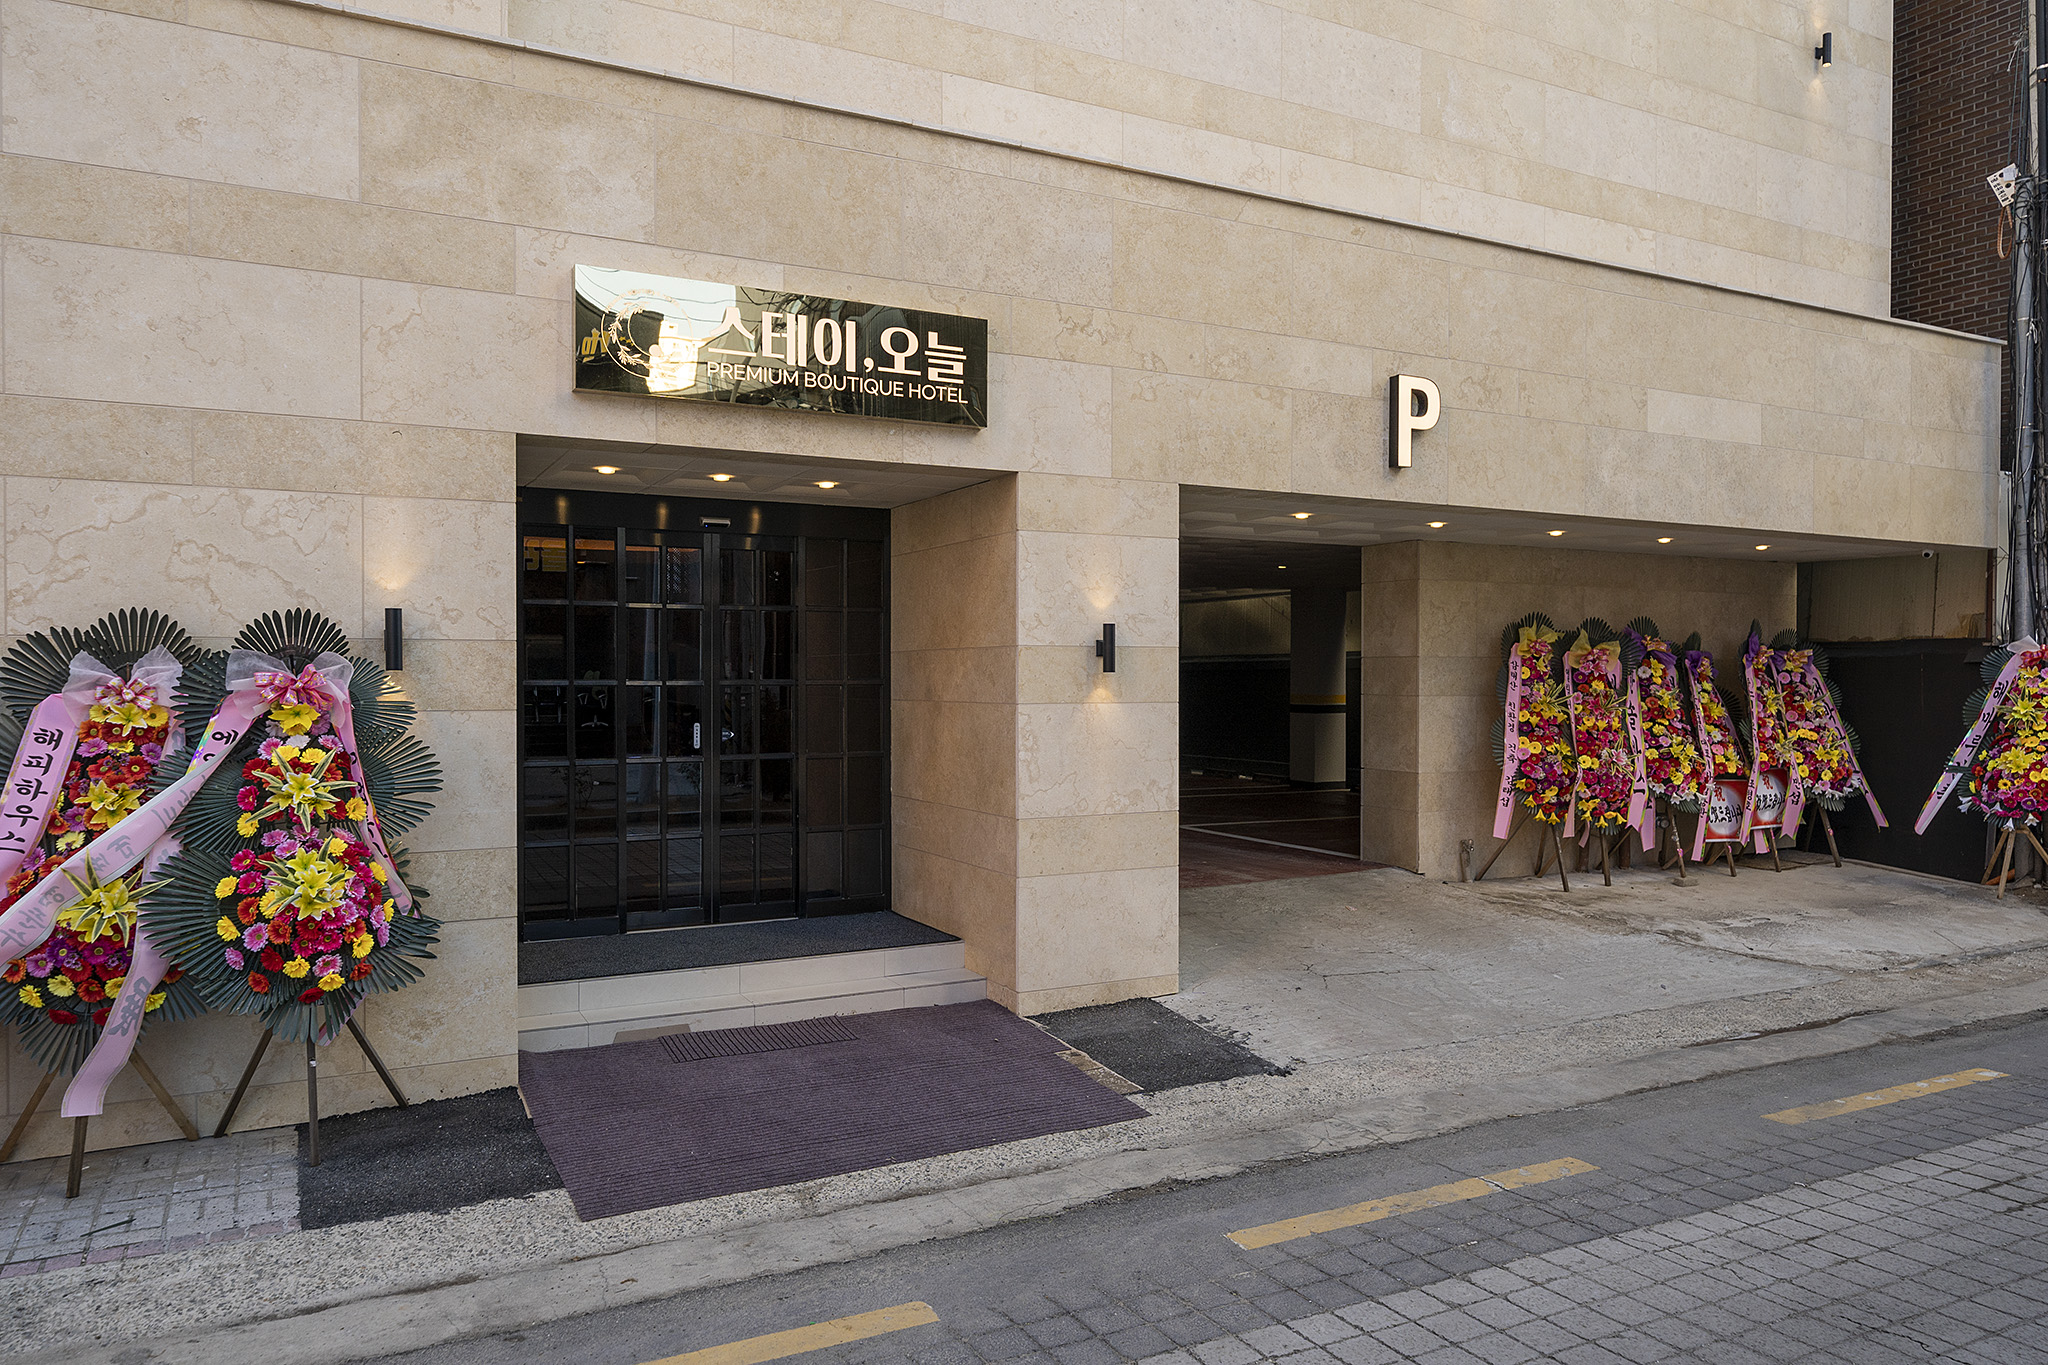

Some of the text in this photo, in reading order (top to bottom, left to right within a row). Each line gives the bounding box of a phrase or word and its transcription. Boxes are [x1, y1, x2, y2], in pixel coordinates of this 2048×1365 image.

[707, 306, 967, 385] 스테이,오늘
[707, 361, 969, 405] PREMIUM BOUTIQUE HOTEL
[1389, 374, 1441, 468] P
[0, 727, 64, 855] 해피하우스
